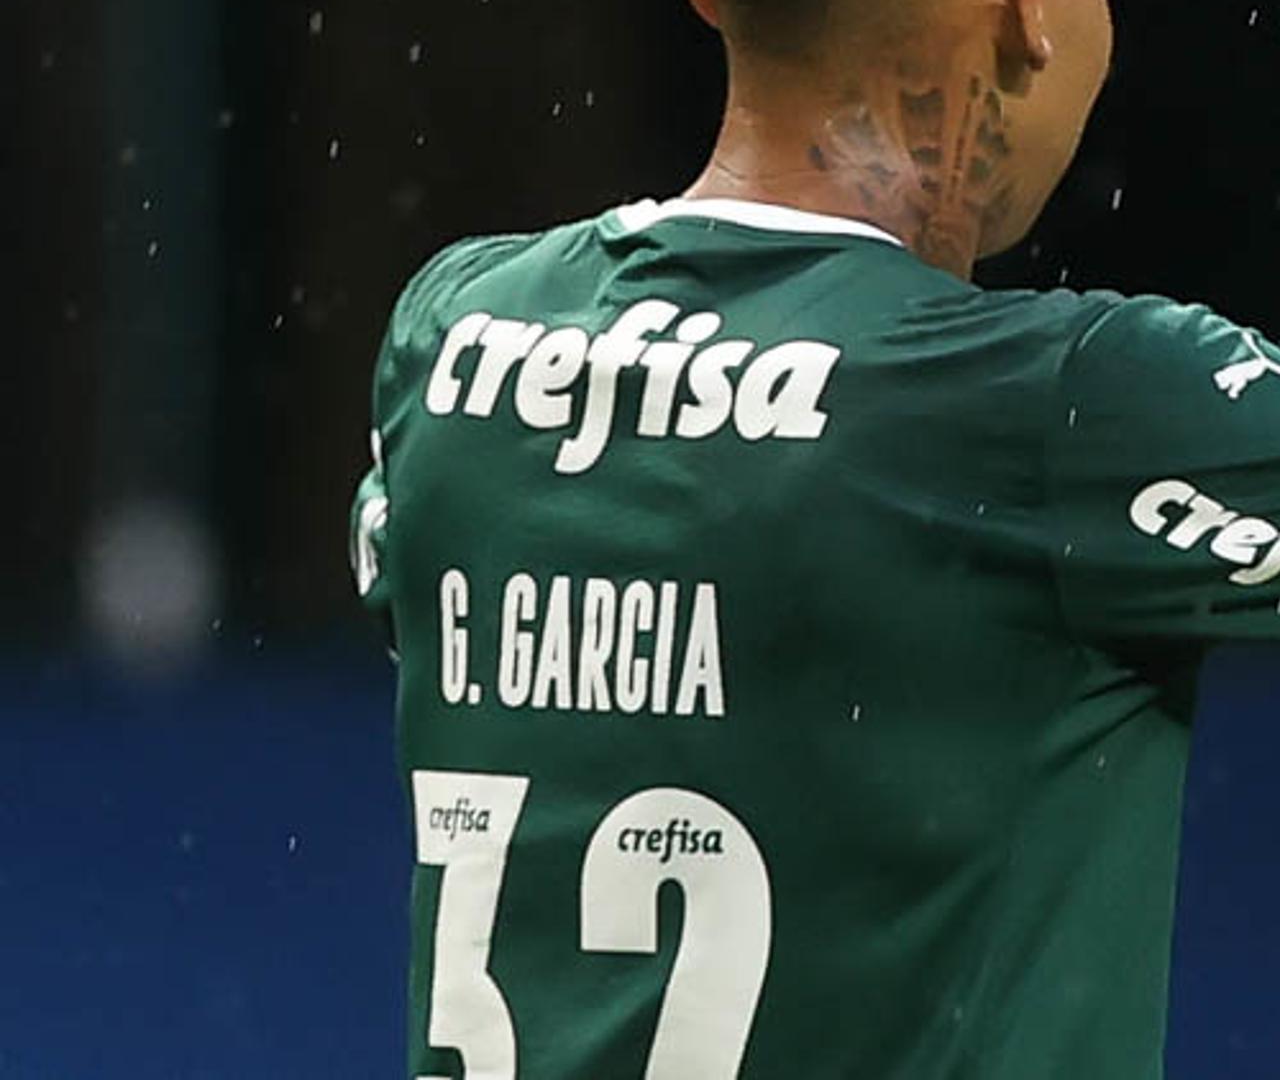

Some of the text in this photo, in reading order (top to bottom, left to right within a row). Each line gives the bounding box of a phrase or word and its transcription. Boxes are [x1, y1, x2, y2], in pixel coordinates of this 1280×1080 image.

[425, 298, 842, 475] crefisa
[440, 568, 726, 718] G. GARCIA
[429, 796, 493, 842] crefisa
[616, 818, 725, 864] crefisa
[411, 769, 774, 1080] 32
